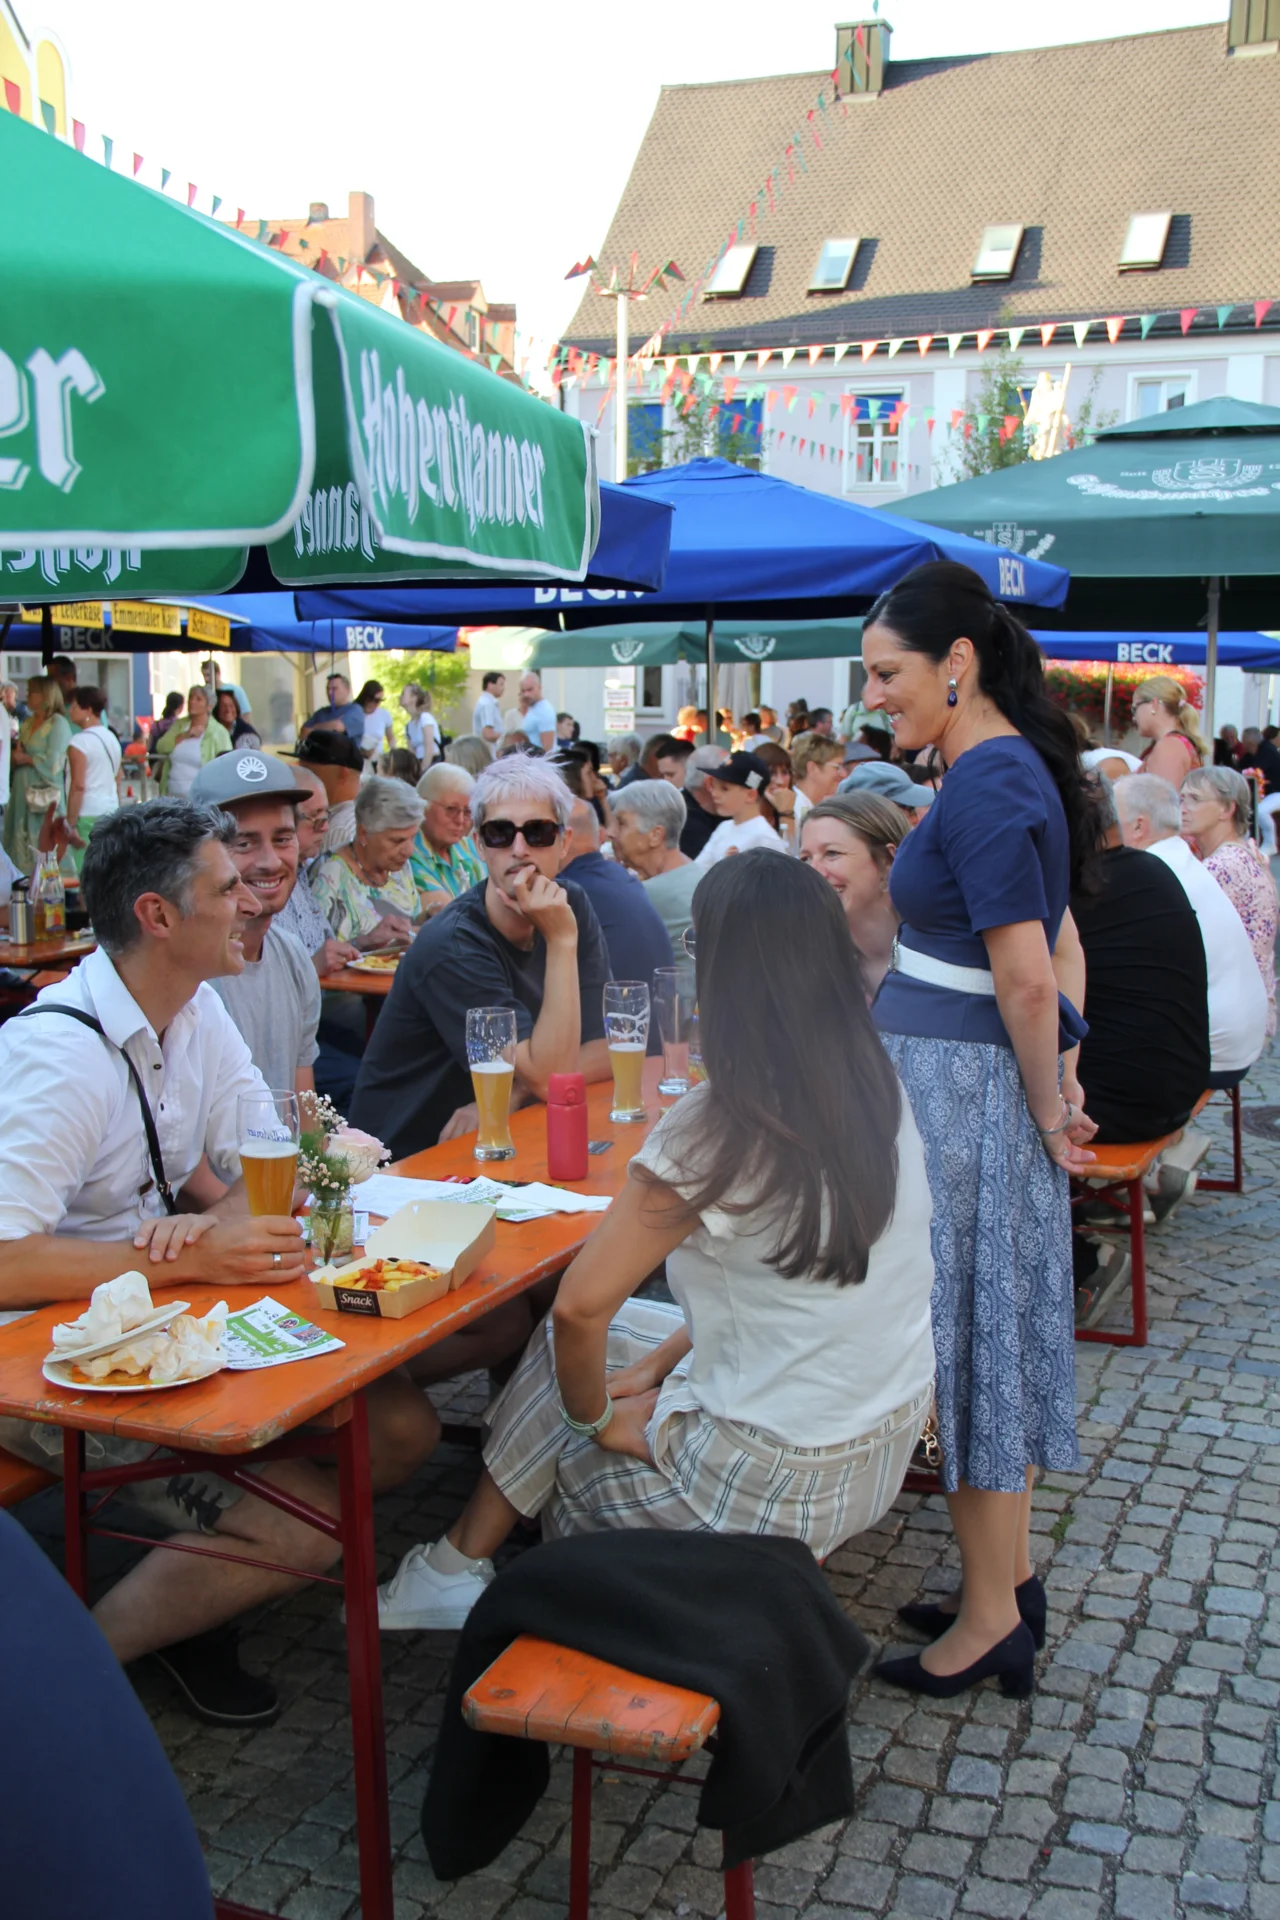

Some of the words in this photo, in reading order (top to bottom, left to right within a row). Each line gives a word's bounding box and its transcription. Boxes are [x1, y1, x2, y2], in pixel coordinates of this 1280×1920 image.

[361, 348, 545, 537] Hohenthanner
[998, 557, 1026, 597] BECK
[60, 627, 113, 650] BECK
[345, 626, 385, 650] BECK
[1117, 643, 1174, 663] BECK
[340, 1293, 373, 1306] Snack
